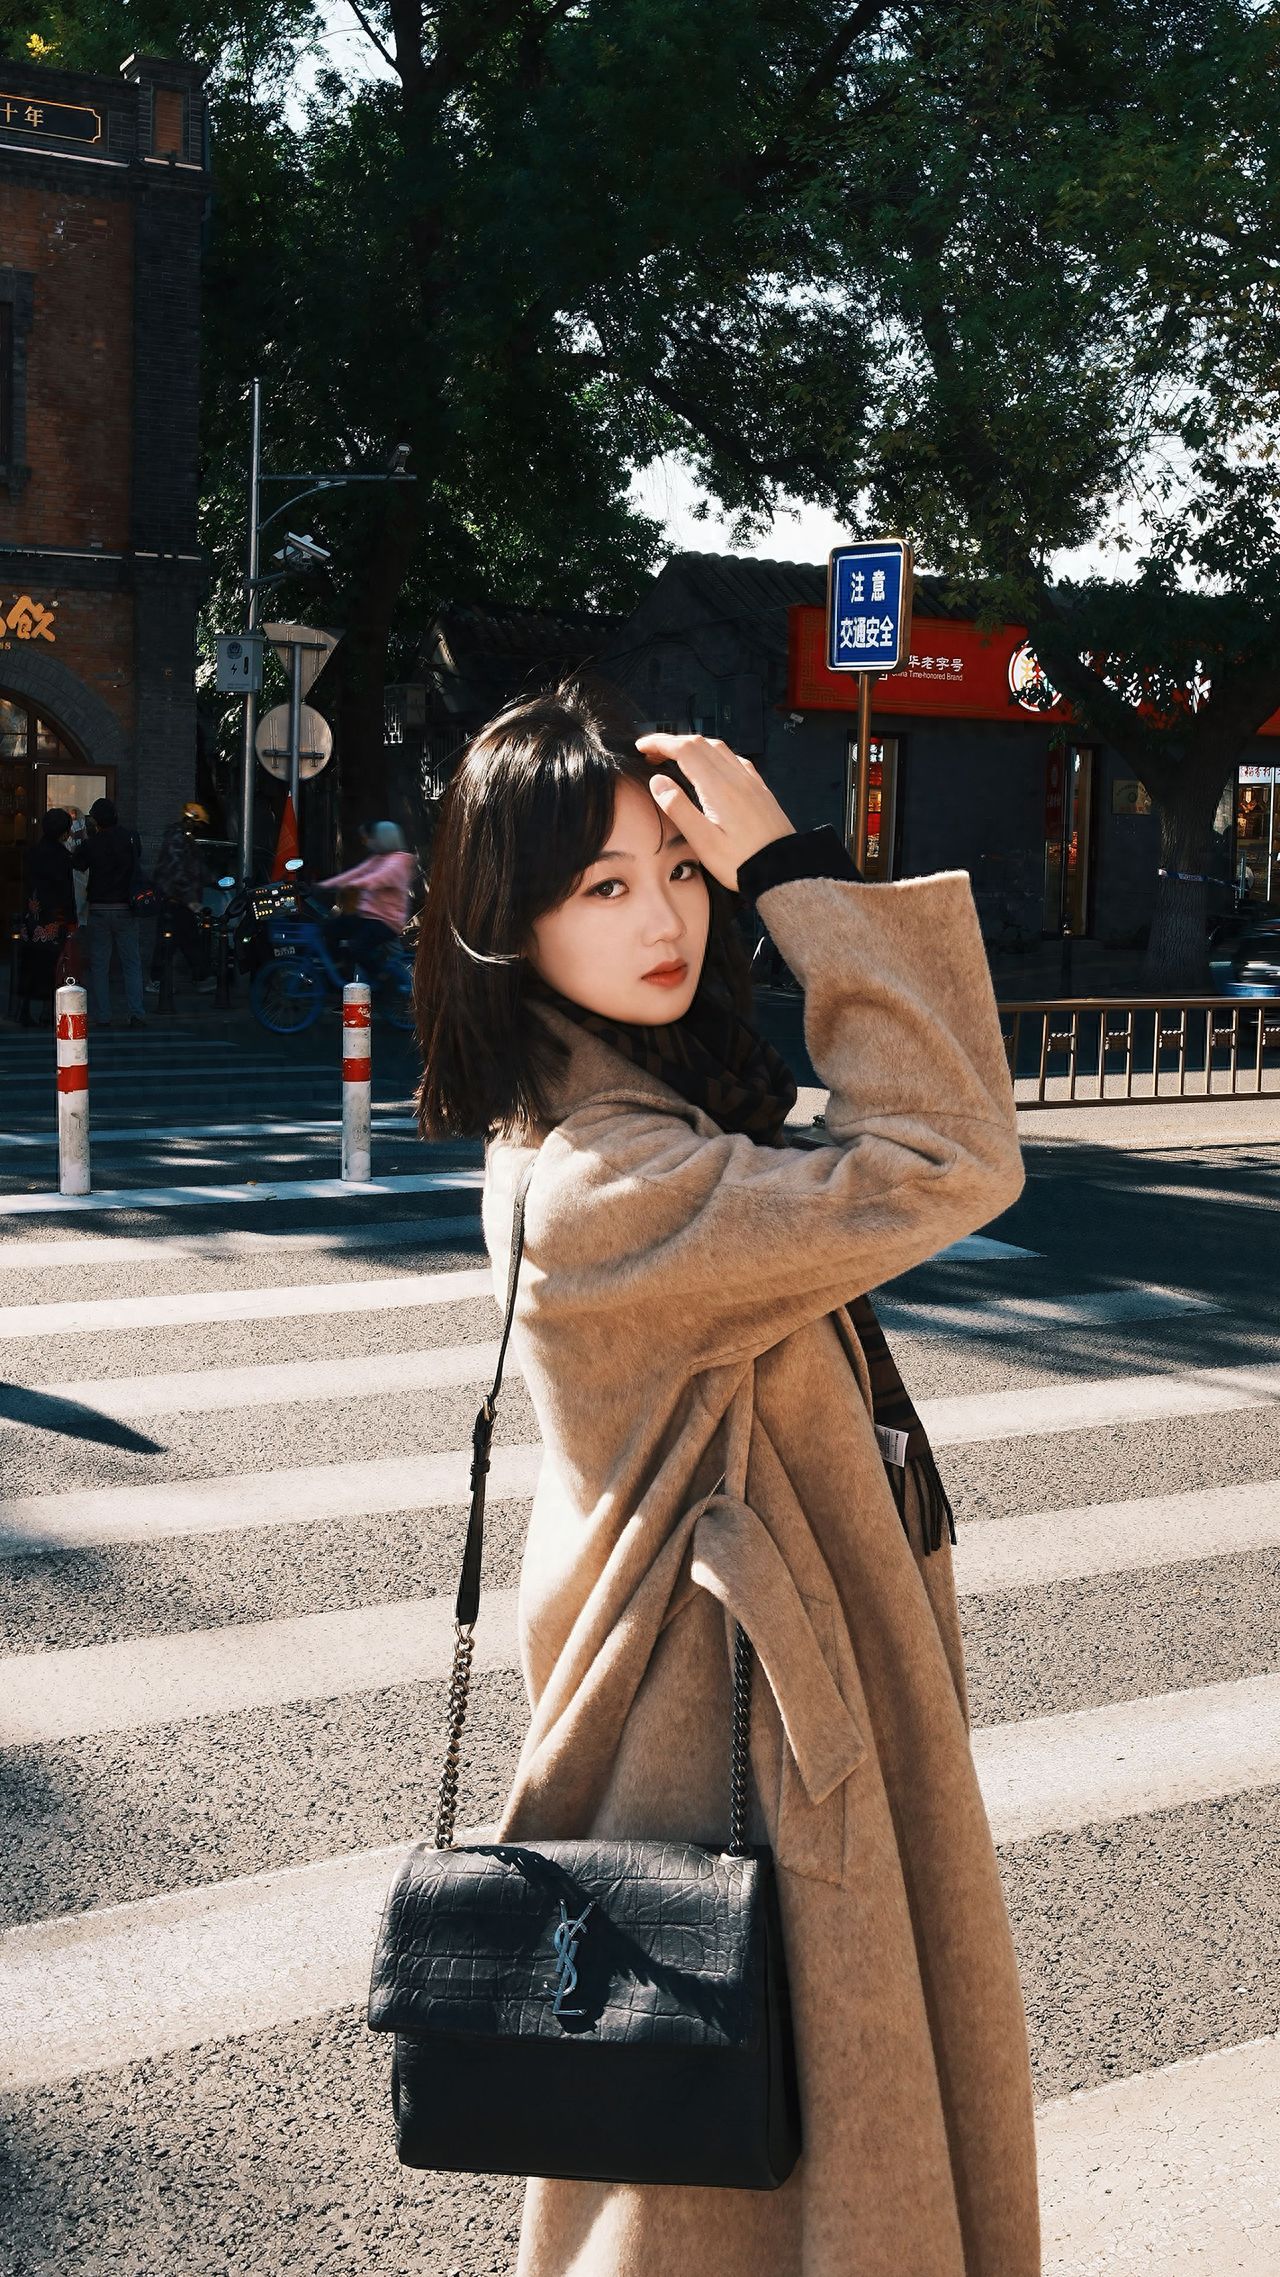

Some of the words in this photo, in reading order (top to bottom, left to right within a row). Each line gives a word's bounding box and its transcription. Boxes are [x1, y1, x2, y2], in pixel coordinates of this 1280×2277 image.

[0, 102, 44, 127] 十年
[850, 569, 886, 603] 注意
[840, 615, 894, 649] 交通安全
[908, 655, 964, 672] 华老字号
[909, 669, 946, 680] Time-honored
[947, 672, 963, 681] Brand
[544, 1898, 597, 2016] YSL
